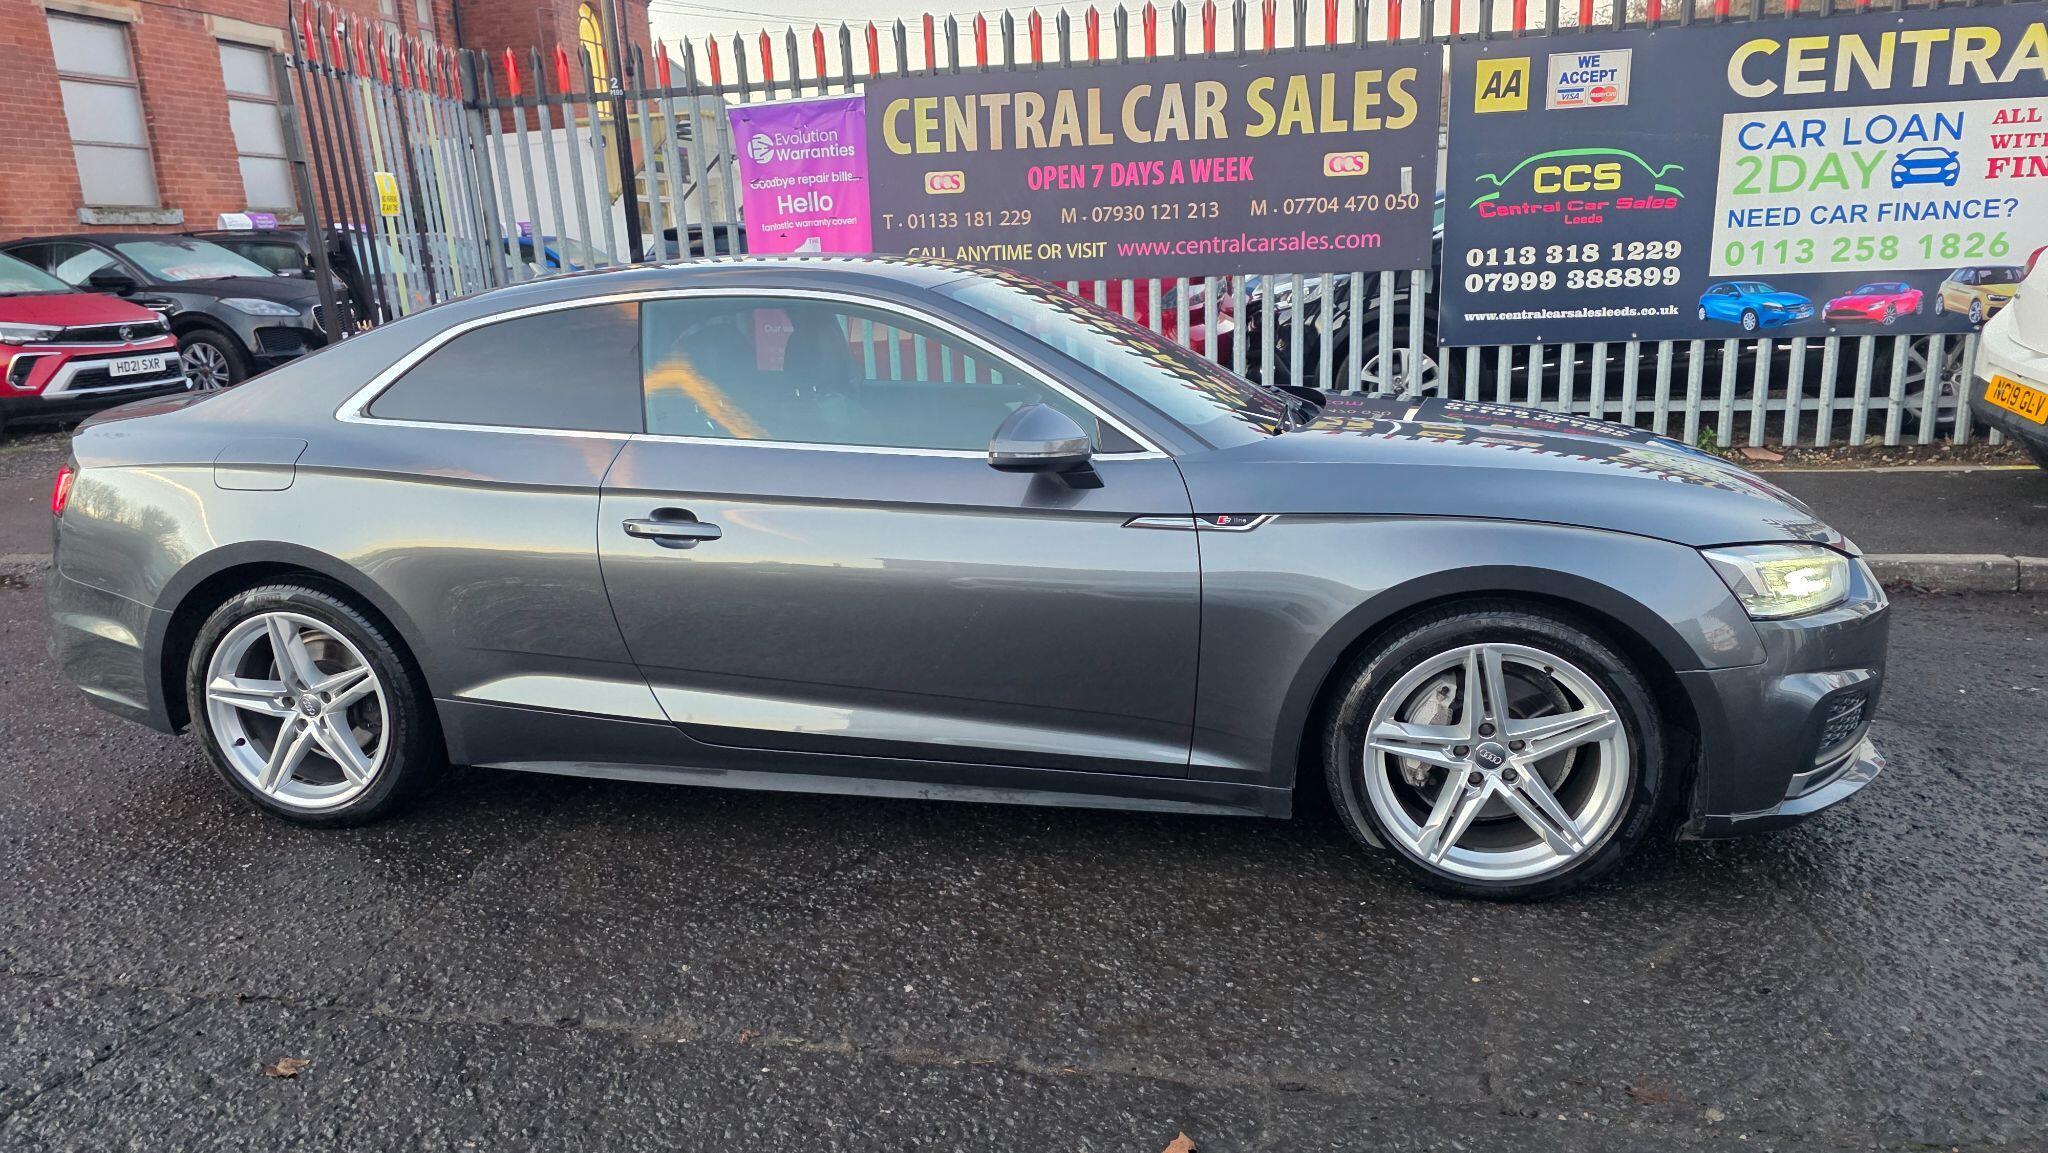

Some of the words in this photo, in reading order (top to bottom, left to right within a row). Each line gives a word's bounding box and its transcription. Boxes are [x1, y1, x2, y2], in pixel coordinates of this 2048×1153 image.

[1578, 55, 1600, 68] WE
[1727, 22, 2048, 98] CENTRA
[610, 77, 619, 88] 2
[1481, 69, 1521, 100] AA
[1559, 68, 1618, 85] ACCEPT
[1561, 92, 1580, 100] VISA
[882, 87, 1114, 155] CENTRAL
[1121, 80, 1229, 144] CAR
[1245, 67, 1419, 138] SALES
[1992, 108, 2042, 124] ALL
[775, 129, 838, 146] Evolution
[1738, 119, 1827, 151] CAR
[1842, 111, 1965, 146] LOAN
[776, 144, 855, 161] Warranties
[750, 175, 795, 190] Goodbye
[798, 172, 829, 187] repair
[1027, 164, 1085, 191] OPEN
[1090, 164, 1105, 188] 7
[1110, 160, 1166, 188] DAYS
[1170, 158, 1185, 185] A
[1189, 156, 1255, 183] WEEK
[1533, 163, 1622, 194] CCS
[1732, 149, 1887, 196] 2DAY
[777, 191, 834, 215] Hello
[1092, 204, 1145, 223] 07930
[1151, 203, 1179, 220] 121
[1187, 201, 1220, 219] 213
[1283, 196, 1339, 215] 07704
[1344, 194, 1379, 212] 470
[1384, 192, 1419, 211] 050
[1478, 200, 1561, 219] Central
[1567, 199, 1610, 211] Car
[1615, 195, 1678, 211] Sales
[1728, 206, 1801, 228] NEED
[1810, 203, 1868, 225] CAR
[1877, 197, 2019, 223] FINANCE?
[761, 220, 794, 232] fantastic
[795, 218, 831, 229] warranty
[907, 213, 958, 230] 01133
[965, 211, 993, 227] 181
[1000, 209, 1032, 226] 229
[1564, 213, 1603, 225] Leeds
[956, 243, 1033, 261] ANYTIME
[1037, 242, 1062, 260] OR
[1066, 241, 1108, 258] VISIT
[1117, 231, 1382, 257] www.centralcarsales.com
[1466, 246, 1537, 267] 0113
[1545, 243, 1600, 265] 318
[1611, 240, 1682, 262] 1229
[1725, 238, 1815, 266] 0113
[1830, 235, 1899, 263] 258
[1917, 231, 2010, 260] 1826
[1464, 270, 1557, 293] 07999
[1566, 266, 1681, 289] 388899
[1464, 305, 1679, 322] www.centralcarsalesleeds.co.uk
[116, 360, 140, 373] HD21
[142, 358, 160, 370] SXR
[1993, 380, 2020, 406] NC19
